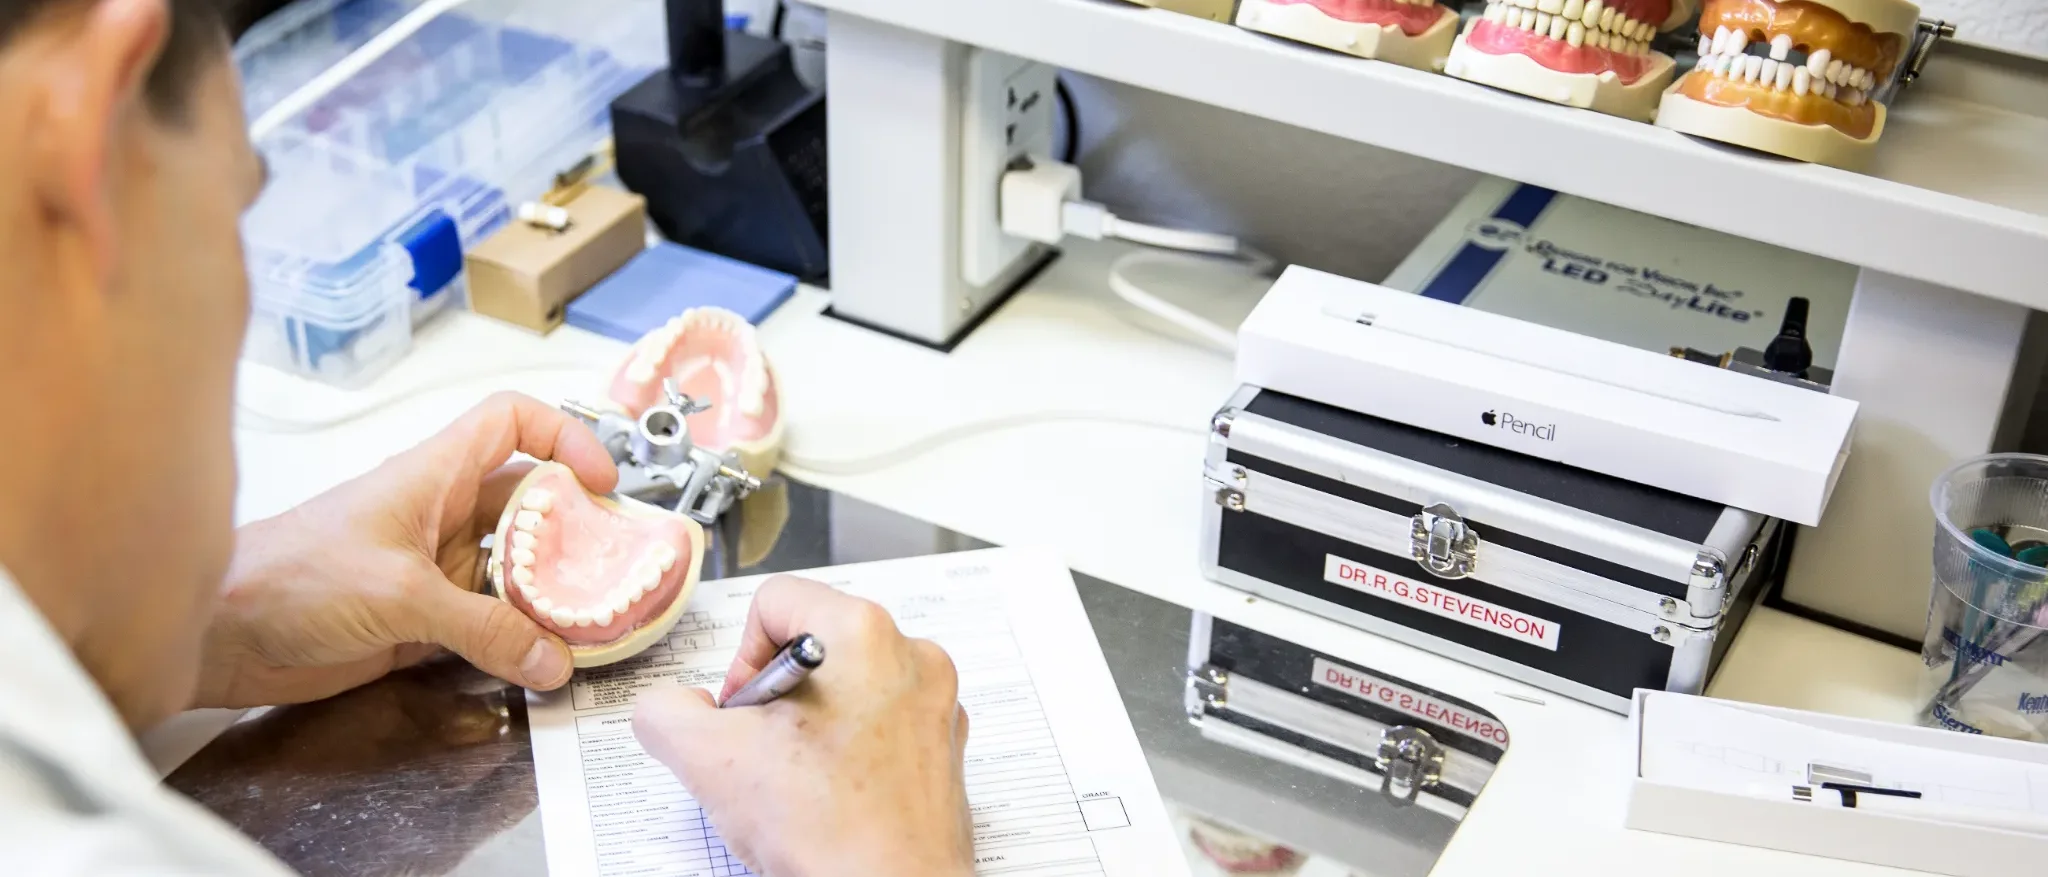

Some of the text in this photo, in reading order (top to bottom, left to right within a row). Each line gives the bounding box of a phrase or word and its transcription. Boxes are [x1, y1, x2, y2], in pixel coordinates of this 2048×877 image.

[1541, 257, 1609, 285] LED
[1500, 412, 1556, 442] Pencil
[1339, 563, 1546, 641] DR.R.G.STEVENSON
